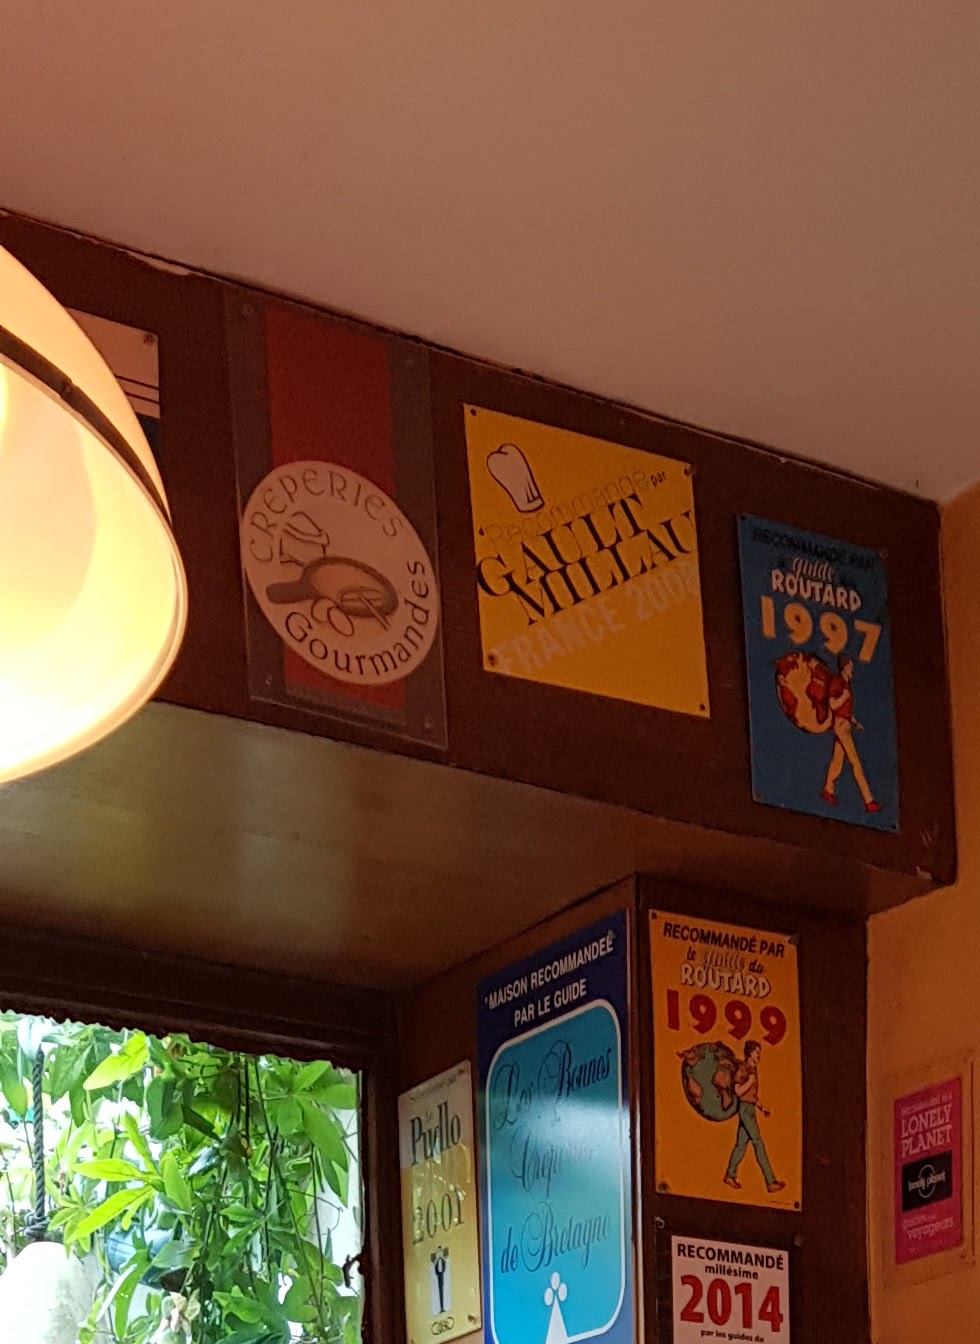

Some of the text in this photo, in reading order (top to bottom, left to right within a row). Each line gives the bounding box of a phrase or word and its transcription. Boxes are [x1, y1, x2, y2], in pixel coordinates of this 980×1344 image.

[650, 471, 666, 489] par
[477, 493, 645, 598] GAULT
[503, 510, 694, 626] MILLAU
[771, 568, 862, 612] ROUTARD
[285, 560, 430, 676] Gourmandes
[760, 594, 882, 664] 1997
[663, 921, 785, 958] RECOMMANDÉ PAR
[681, 963, 771, 999] ROUTARD
[749, 960, 764, 974] du
[488, 974, 528, 1010] MAISON
[514, 978, 587, 1028] PAR LE GUIDE
[666, 988, 787, 1046] 1999
[537, 1039, 612, 1127] Bonnes
[901, 1103, 952, 1138] LONELY
[901, 1124, 952, 1159] PLANET
[500, 1201, 611, 1274] de Bretagne
[676, 1243, 784, 1271] RECOMMANDÉ
[704, 1264, 759, 1280] millésime
[680, 1274, 783, 1333] 2014
